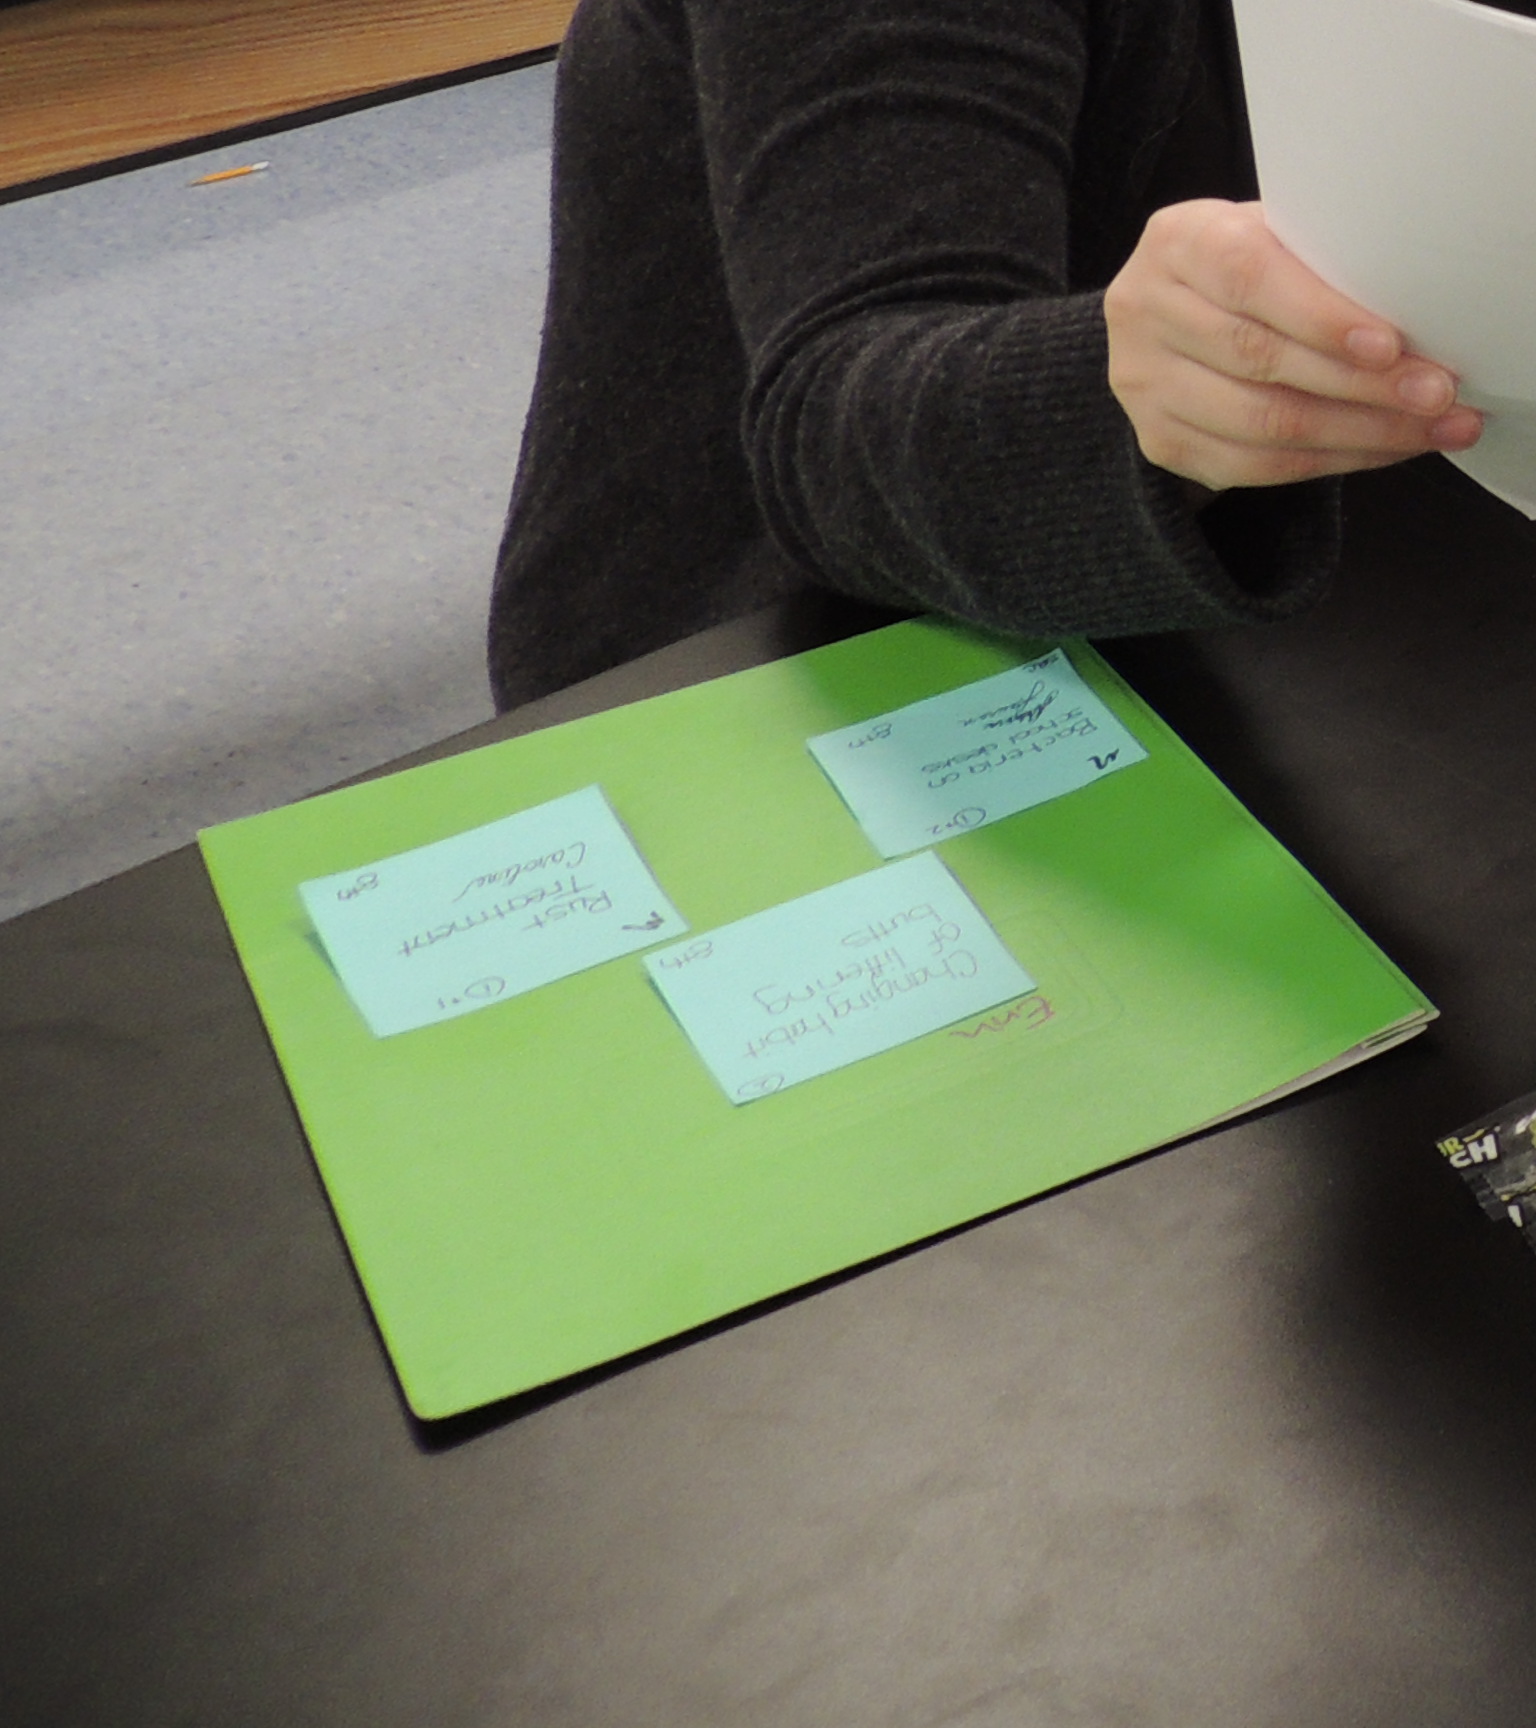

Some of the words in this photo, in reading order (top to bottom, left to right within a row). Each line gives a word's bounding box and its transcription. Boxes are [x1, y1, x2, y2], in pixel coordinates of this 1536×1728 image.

[966, 717, 1099, 778] Bacteria
[1008, 707, 1084, 746] school
[920, 743, 999, 775] desks
[927, 772, 961, 791] on
[337, 871, 380, 903] 8th
[451, 840, 588, 904] Caroline
[397, 874, 596, 959] Treatment
[520, 888, 613, 934] Rust
[840, 903, 943, 950] butts
[926, 919, 962, 954] of
[751, 947, 906, 1016] littering
[831, 948, 979, 1025] Changing
[743, 1007, 831, 1061] habit
